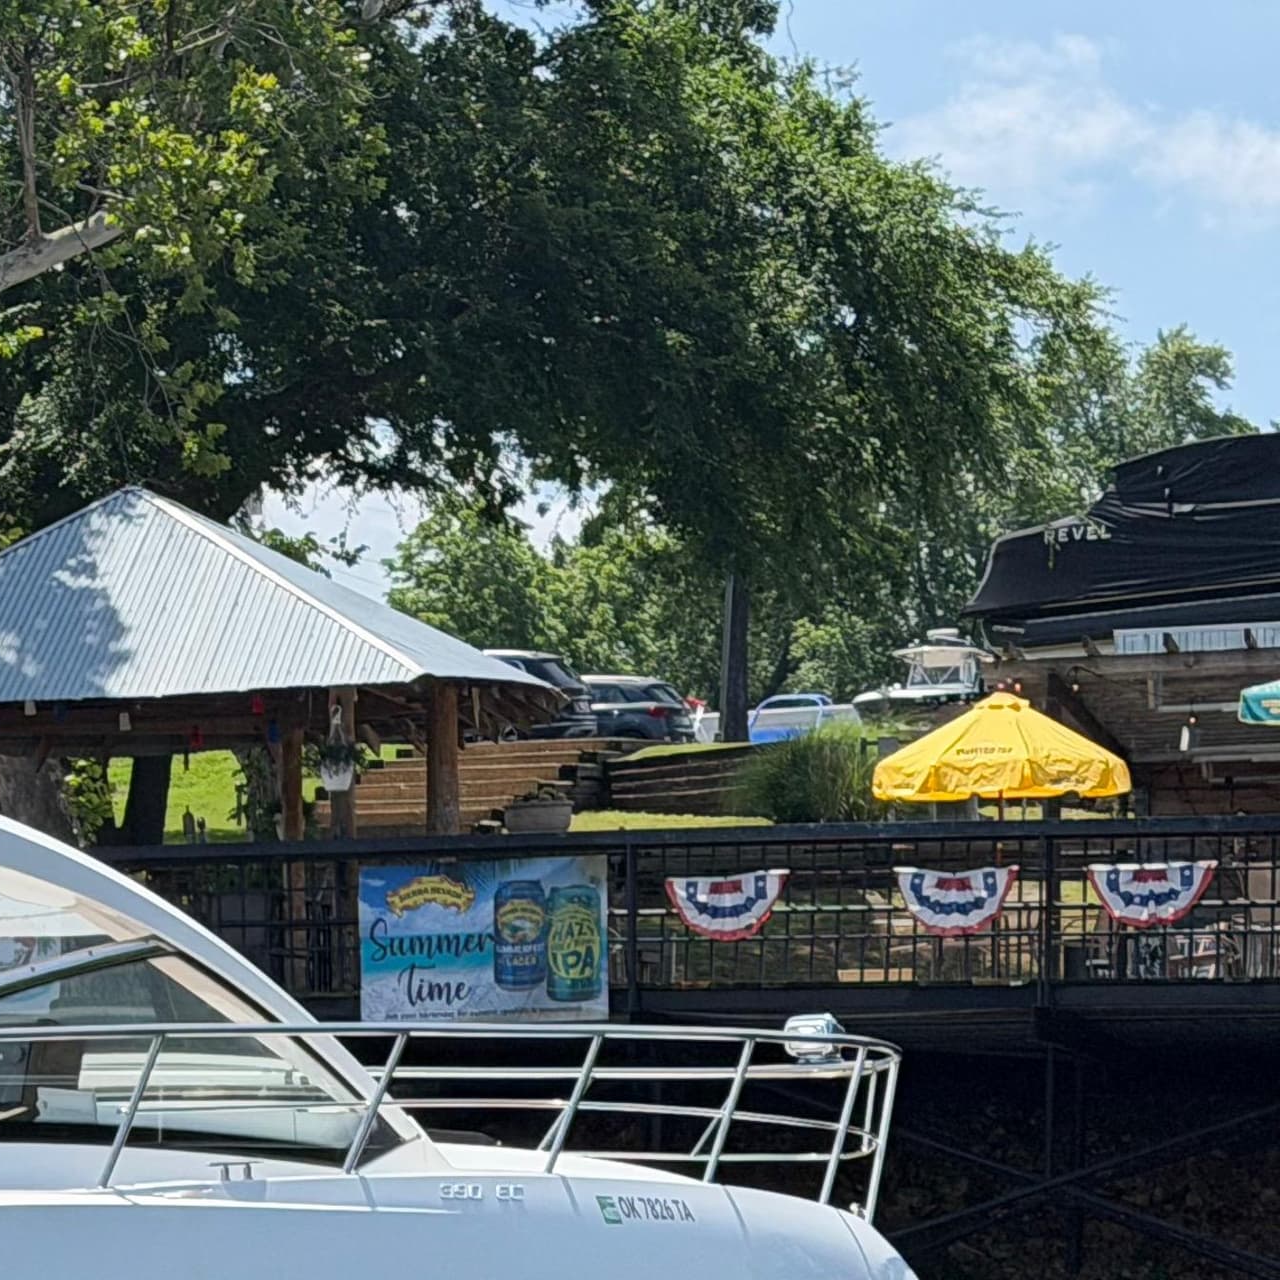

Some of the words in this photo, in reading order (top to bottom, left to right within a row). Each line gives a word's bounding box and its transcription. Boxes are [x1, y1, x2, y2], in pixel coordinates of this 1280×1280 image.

[1044, 525, 1112, 551] REVEL
[369, 917, 496, 962] Summer
[551, 945, 594, 976] IPA
[398, 963, 471, 1007] Time
[617, 1195, 642, 1220] OK
[638, 1197, 675, 1222] 7826
[672, 1199, 696, 1223] TA
